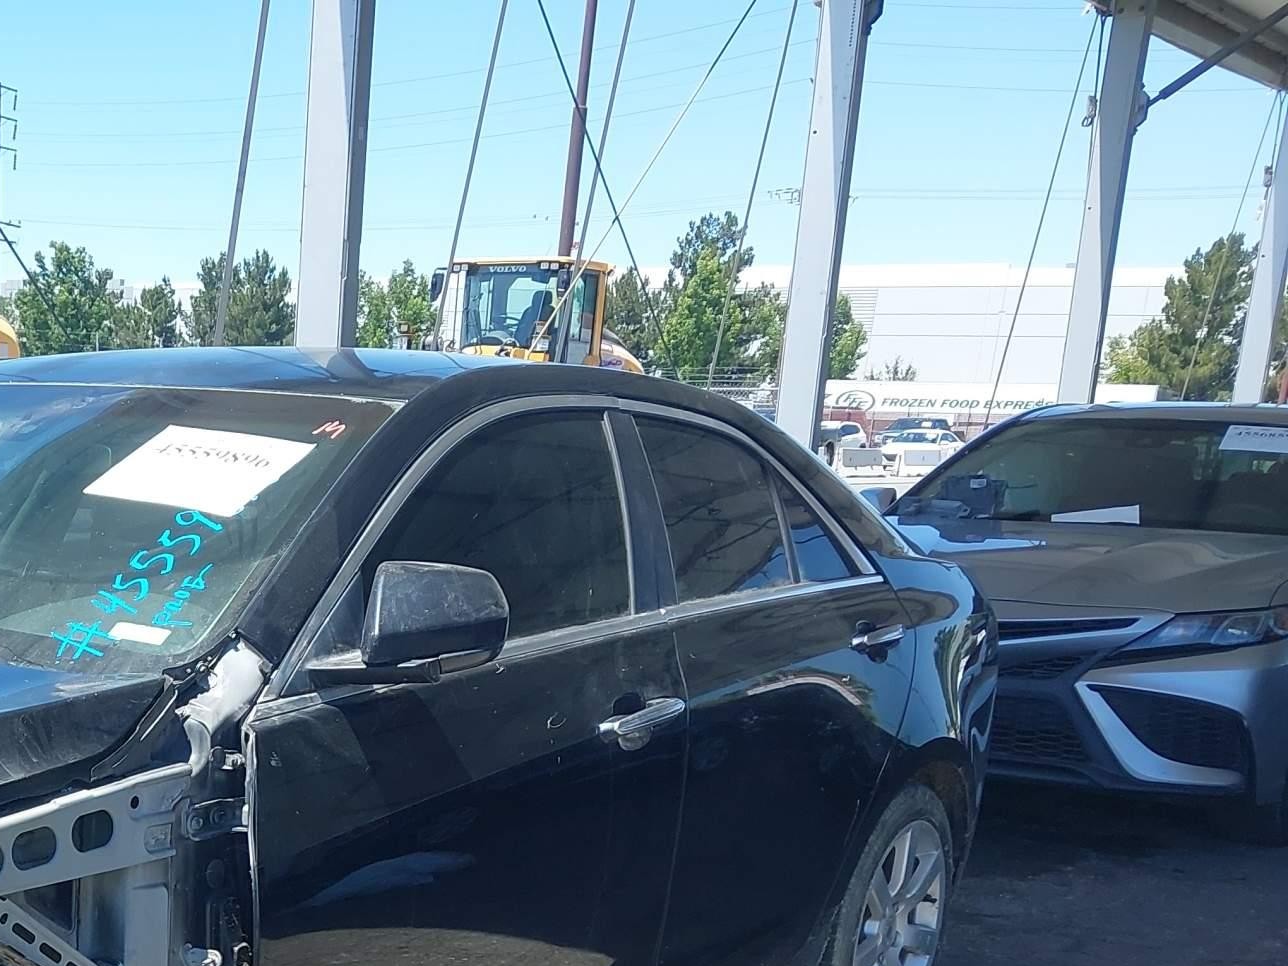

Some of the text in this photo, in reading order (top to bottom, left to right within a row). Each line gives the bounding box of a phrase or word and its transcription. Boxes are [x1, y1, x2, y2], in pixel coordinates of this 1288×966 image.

[489, 264, 527, 274] VOLVO
[881, 397, 937, 408] FROZEN
[940, 399, 980, 409] FOOD
